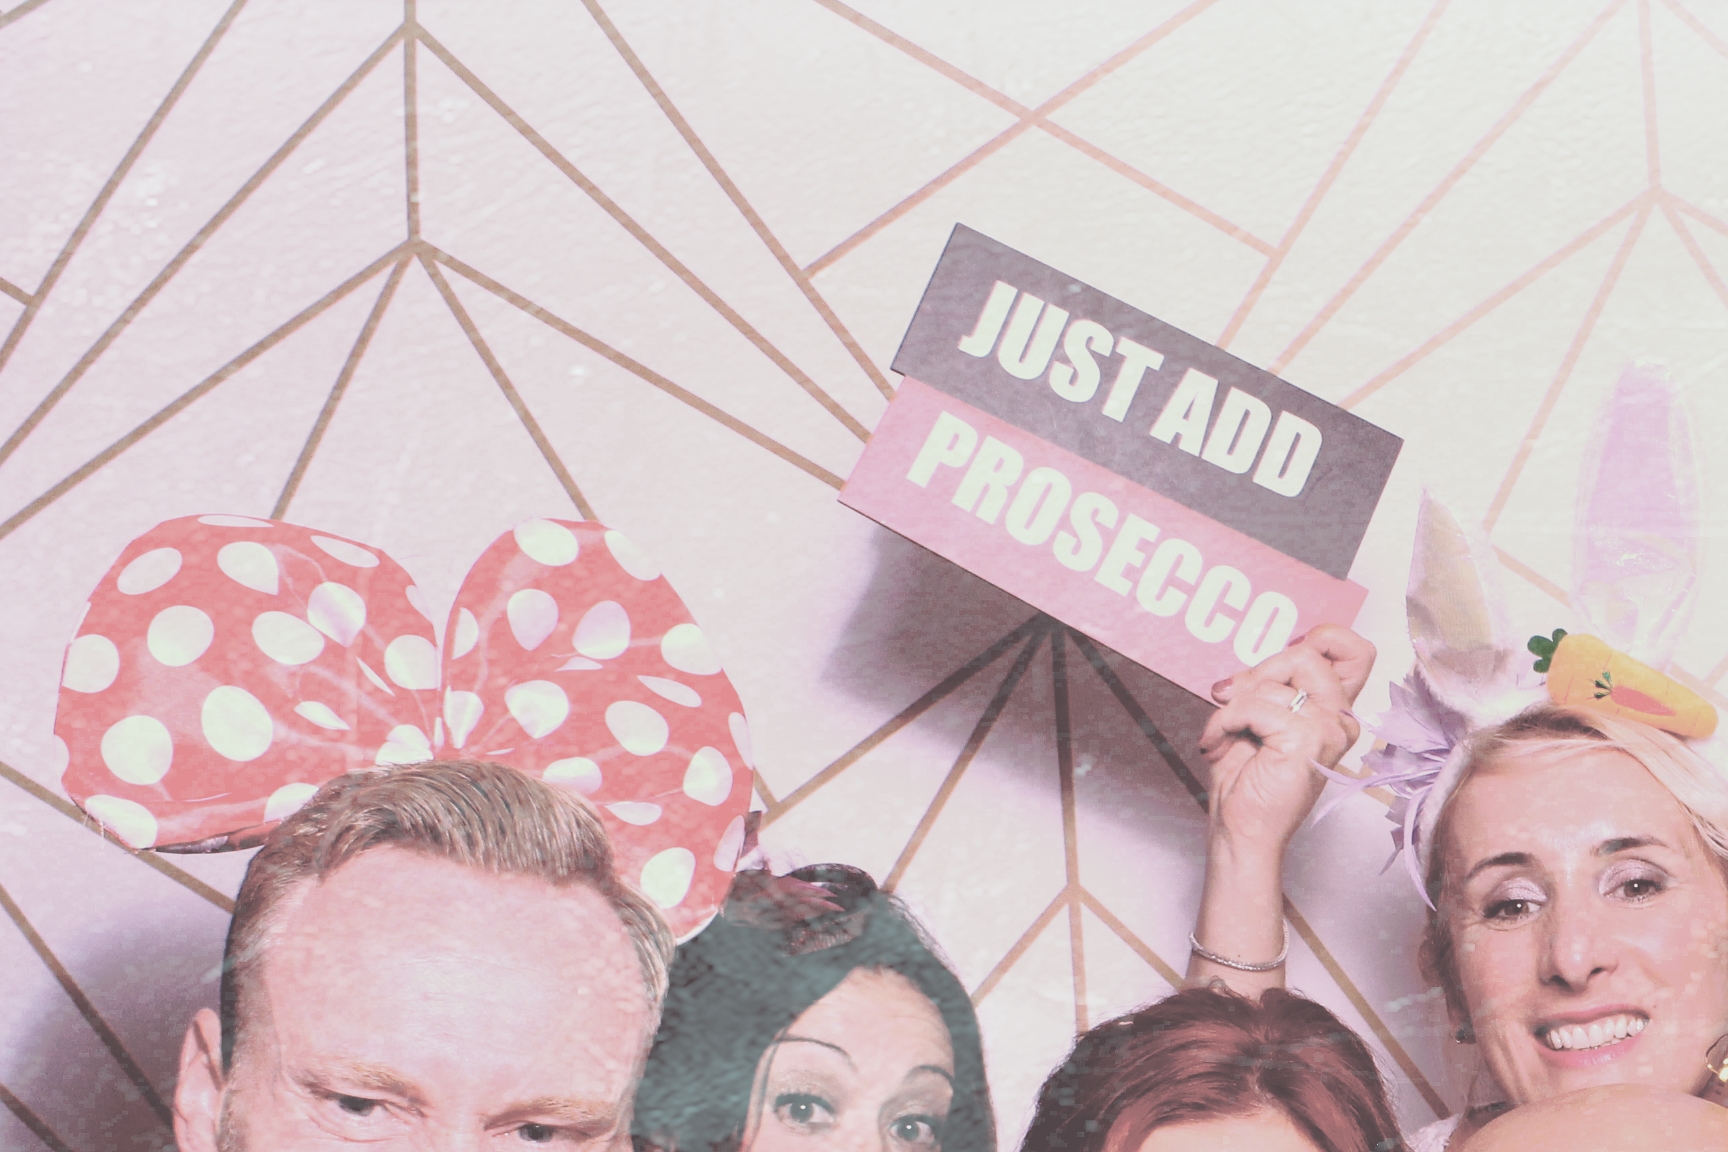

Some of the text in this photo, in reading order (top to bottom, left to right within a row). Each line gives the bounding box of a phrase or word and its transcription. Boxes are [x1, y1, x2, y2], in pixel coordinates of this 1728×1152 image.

[957, 280, 1323, 498] JUST ADD
[906, 411, 1298, 667] PROSECCO
